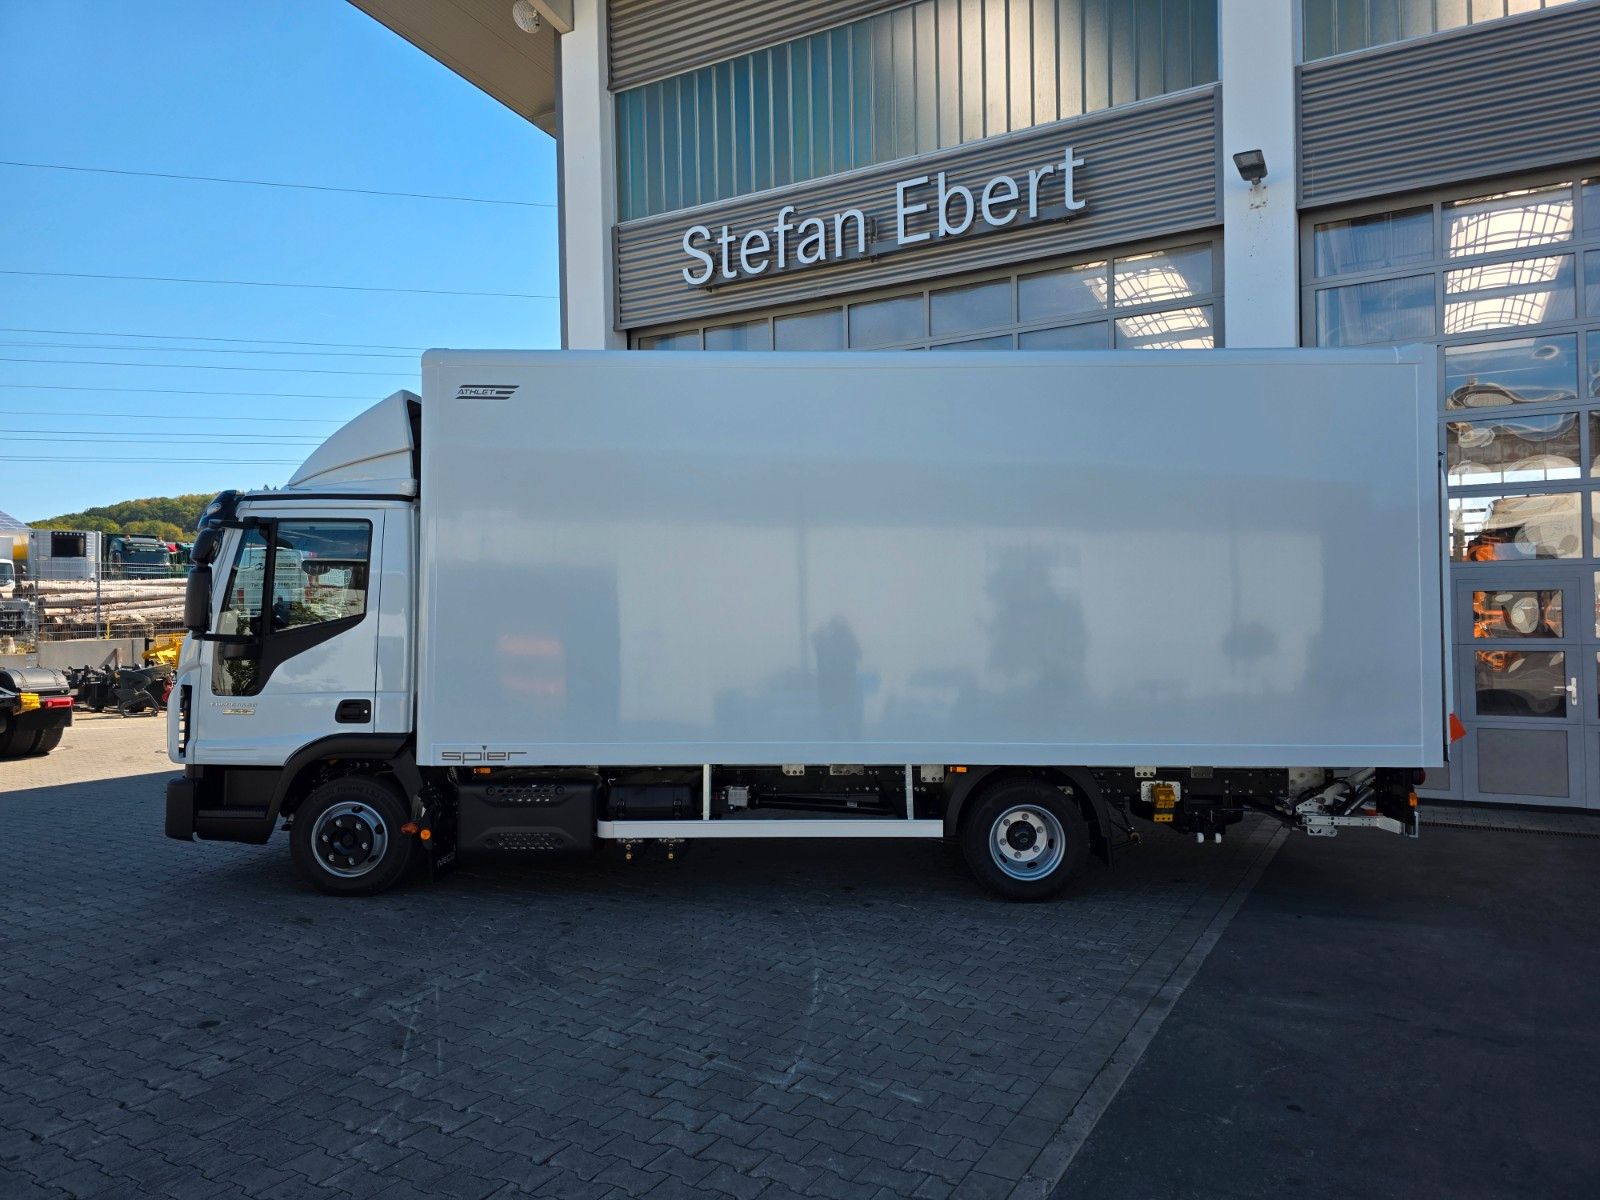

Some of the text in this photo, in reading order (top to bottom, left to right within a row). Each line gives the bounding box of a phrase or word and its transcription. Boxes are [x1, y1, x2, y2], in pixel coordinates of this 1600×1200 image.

[682, 147, 1086, 285] Stefan Ebert
[442, 745, 527, 764] spier
